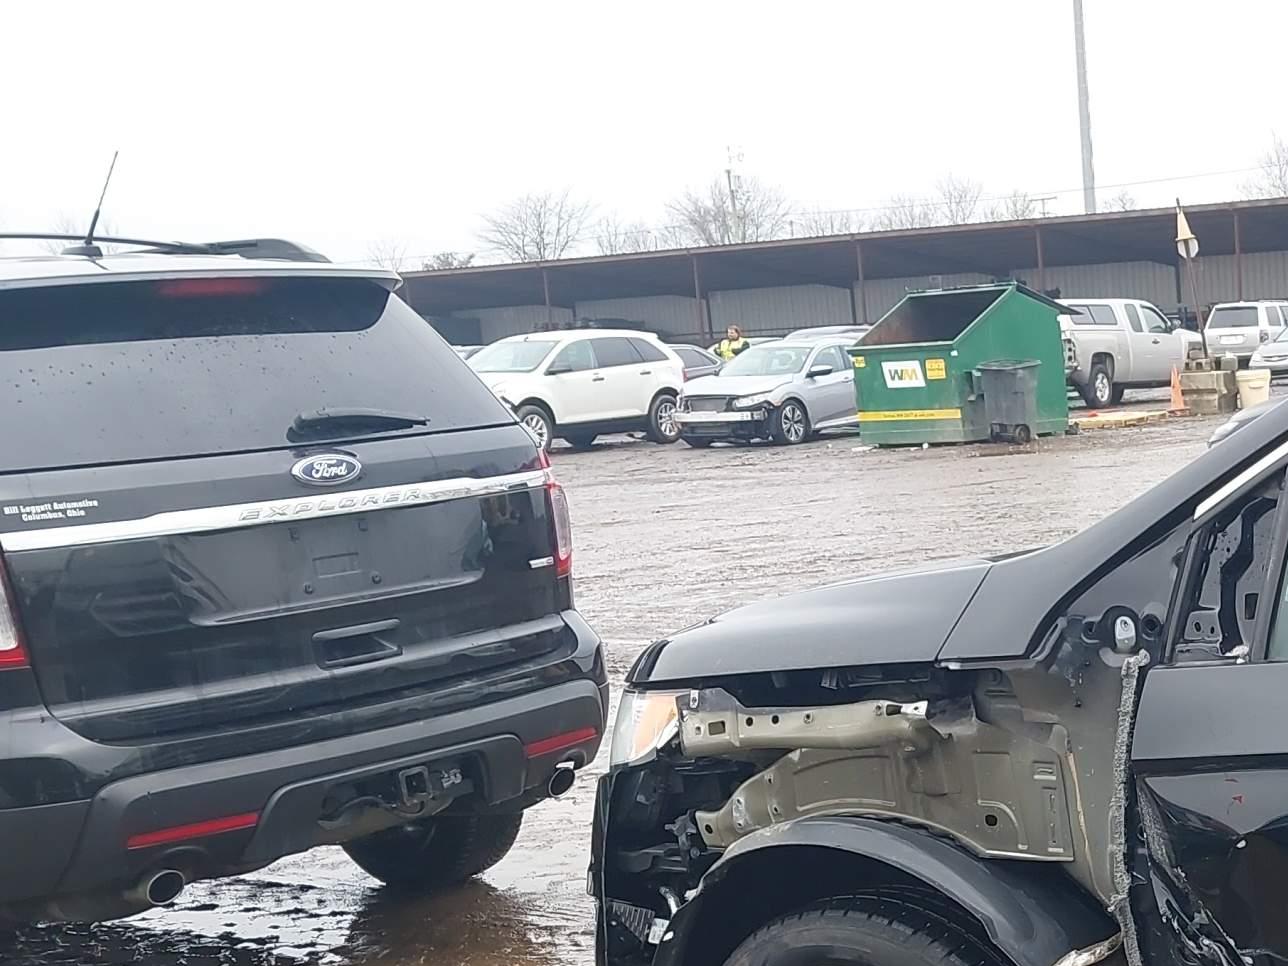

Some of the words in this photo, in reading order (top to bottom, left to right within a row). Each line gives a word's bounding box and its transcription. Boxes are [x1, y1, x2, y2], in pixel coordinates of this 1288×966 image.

[888, 368, 918, 381] WM
[311, 459, 348, 479] Ford
[3, 505, 20, 515] Bill
[53, 499, 98, 510] Automotive
[238, 488, 422, 521] EXPLORER
[66, 509, 86, 517] Ohio
